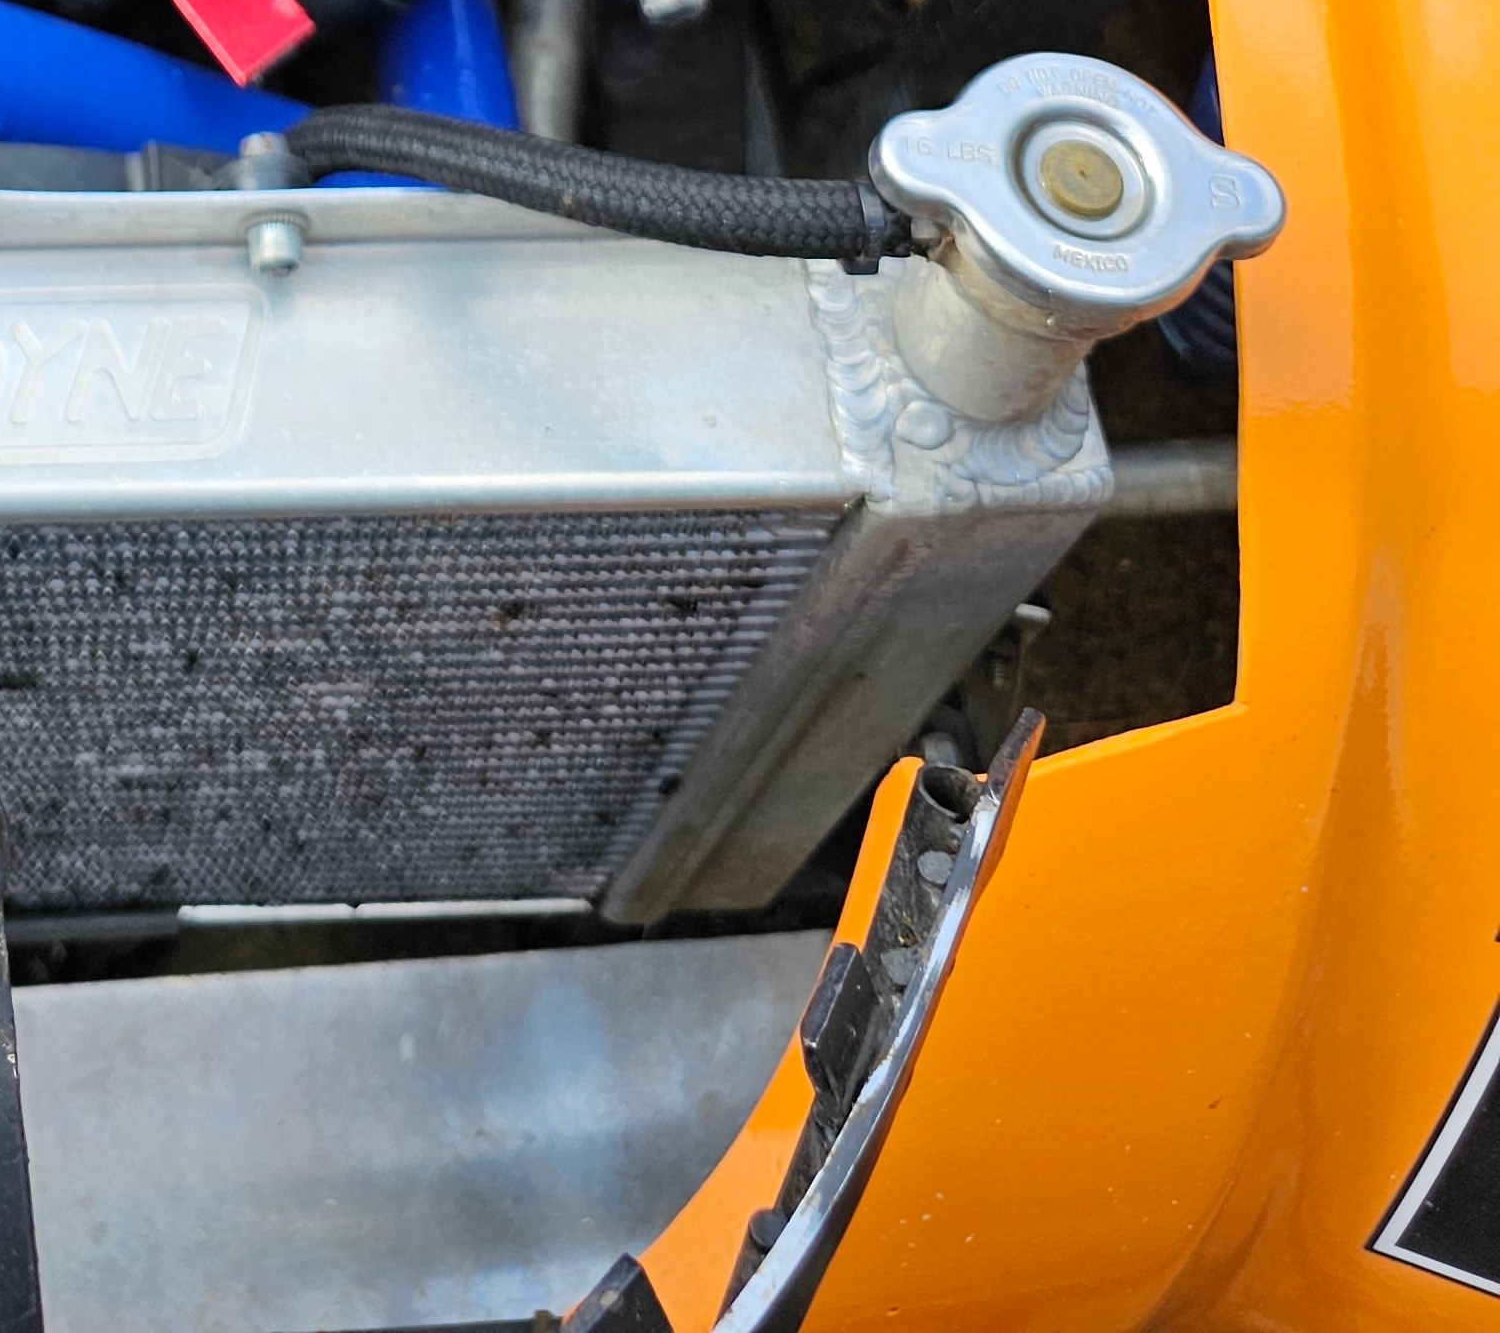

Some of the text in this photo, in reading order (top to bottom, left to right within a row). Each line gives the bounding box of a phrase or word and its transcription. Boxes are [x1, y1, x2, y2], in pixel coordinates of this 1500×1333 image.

[1025, 65, 1060, 84] NOT
[1035, 81, 1121, 109] WARNING
[902, 135, 932, 156] 16
[1052, 242, 1129, 272] MEXICO
